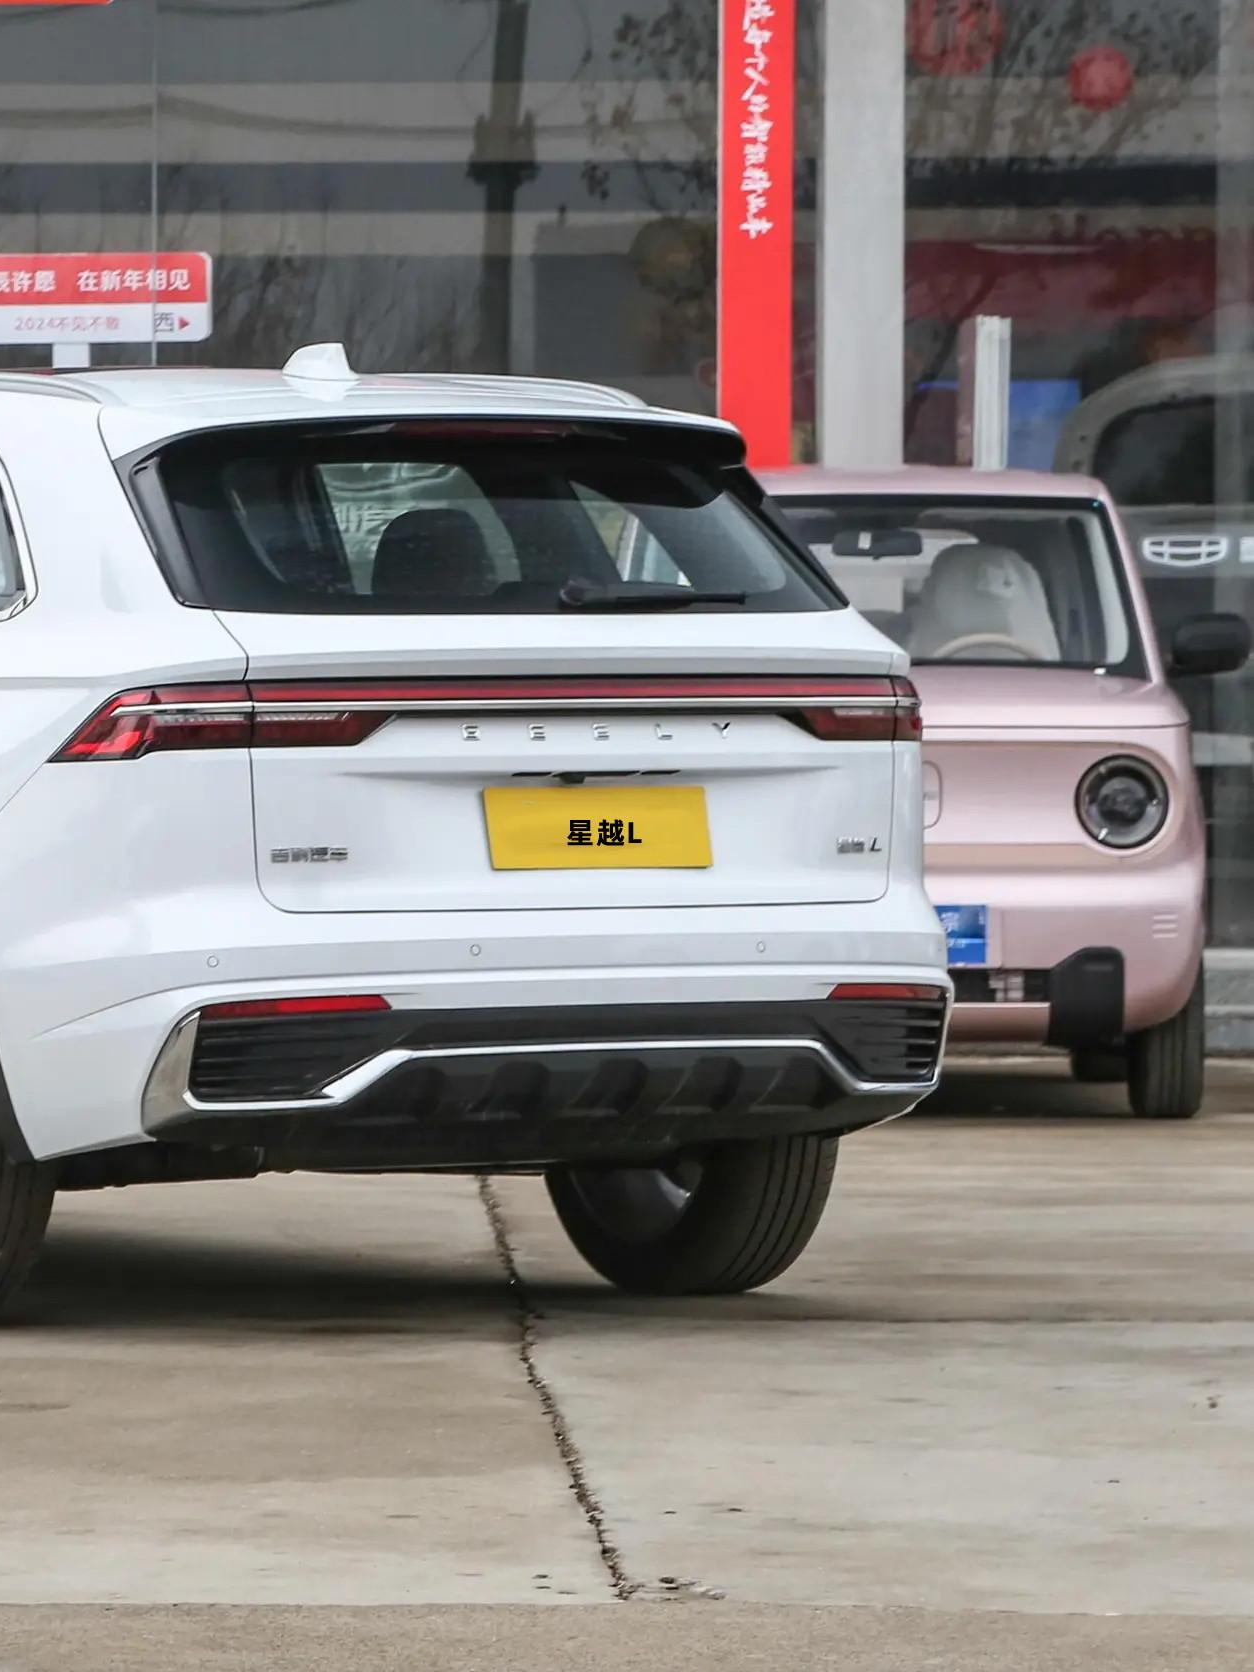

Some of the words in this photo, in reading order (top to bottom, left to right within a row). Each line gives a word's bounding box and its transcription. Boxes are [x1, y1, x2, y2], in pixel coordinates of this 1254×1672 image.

[77, 268, 191, 292] 在新年相见
[154, 313, 175, 332] 西
[461, 722, 731, 741] GEELY
[567, 820, 642, 846] 星越L
